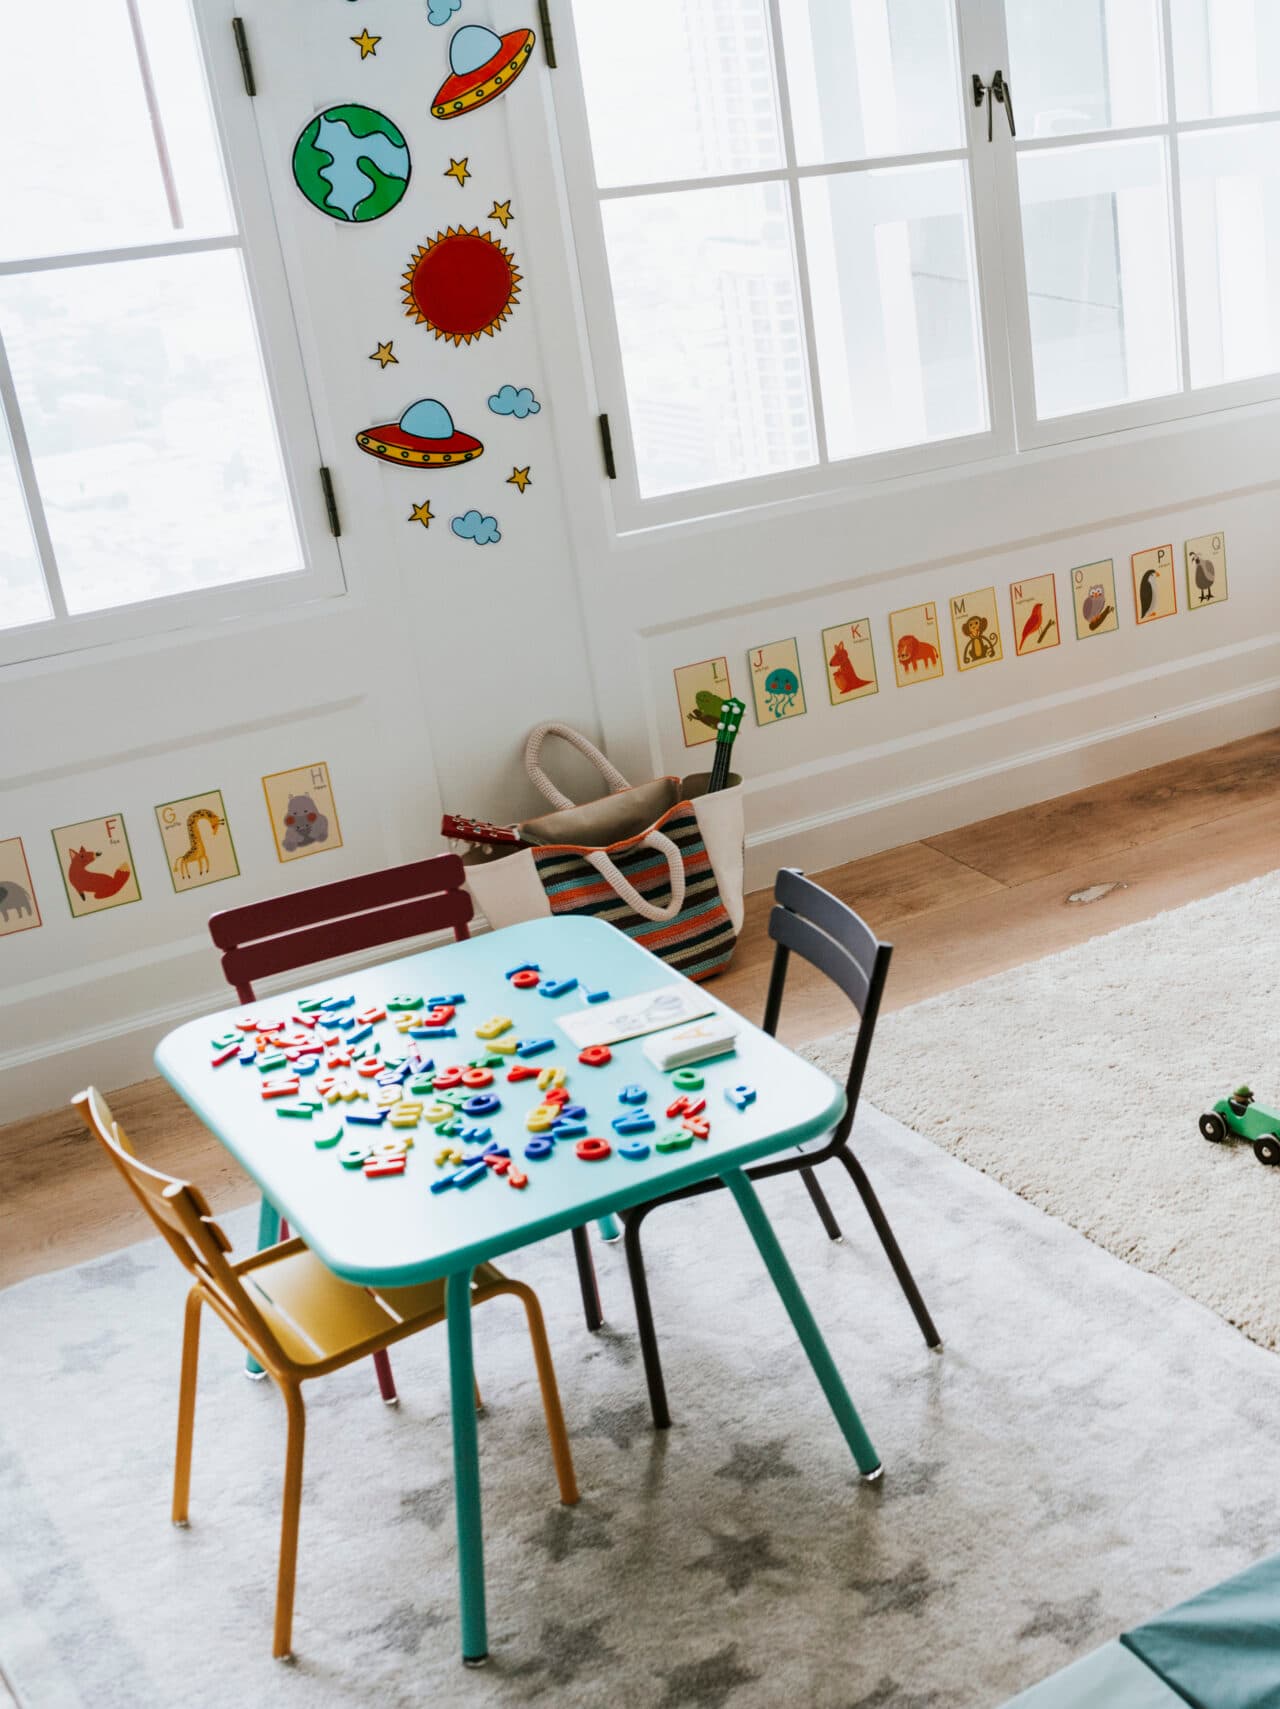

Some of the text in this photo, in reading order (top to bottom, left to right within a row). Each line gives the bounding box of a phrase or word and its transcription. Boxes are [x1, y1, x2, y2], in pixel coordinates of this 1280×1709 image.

[1157, 549, 1165, 563] P
[1014, 587, 1023, 598] N
[925, 607, 935, 621] L
[954, 598, 967, 614] M
[851, 624, 862, 638] K
[753, 650, 763, 667] J
[311, 767, 324, 784] H
[163, 807, 176, 824] G
[105, 819, 117, 838] F
